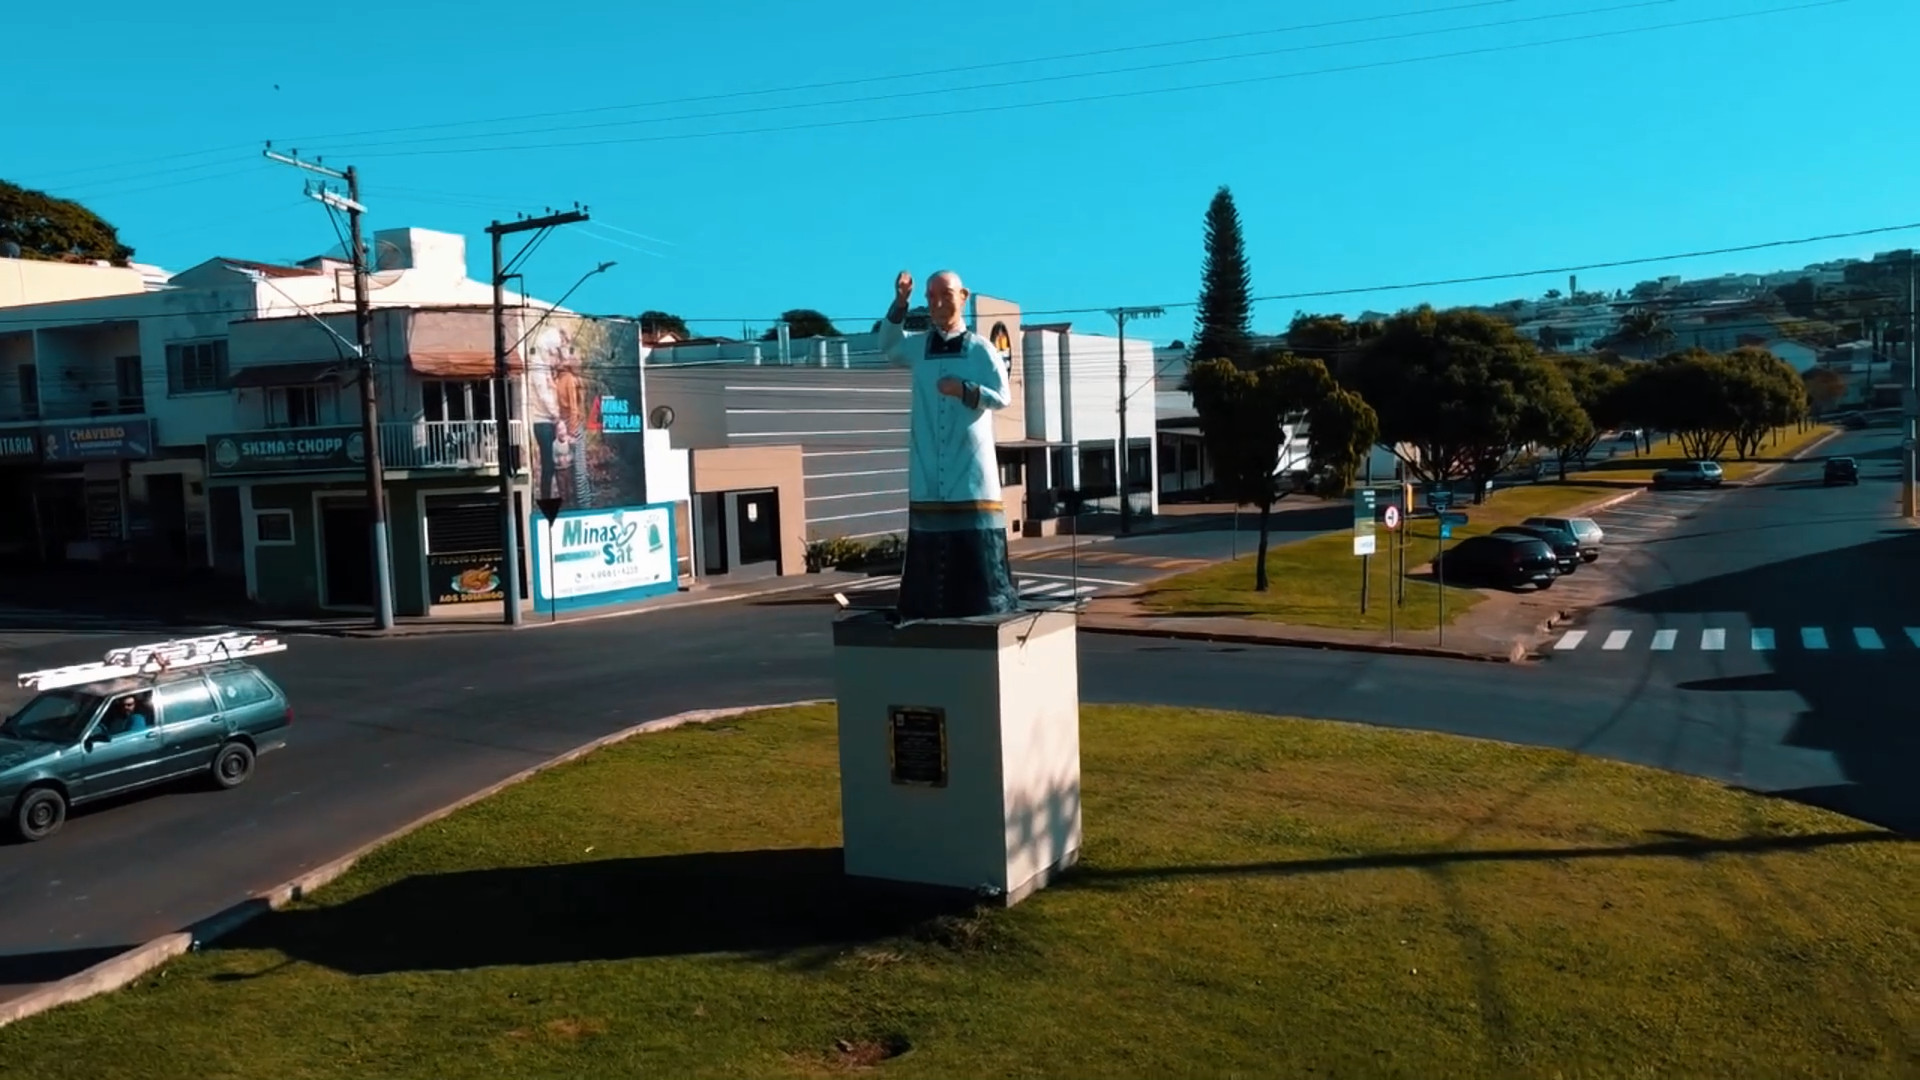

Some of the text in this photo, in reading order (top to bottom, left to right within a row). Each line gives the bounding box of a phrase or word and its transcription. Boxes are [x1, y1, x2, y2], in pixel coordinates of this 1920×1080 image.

[601, 399, 629, 414] MINAS
[602, 414, 641, 429] POPULAR
[70, 426, 126, 441] CHAVEIRO
[296, 437, 343, 453] CHOPP
[562, 519, 618, 548] Minas
[602, 543, 634, 566] Sat
